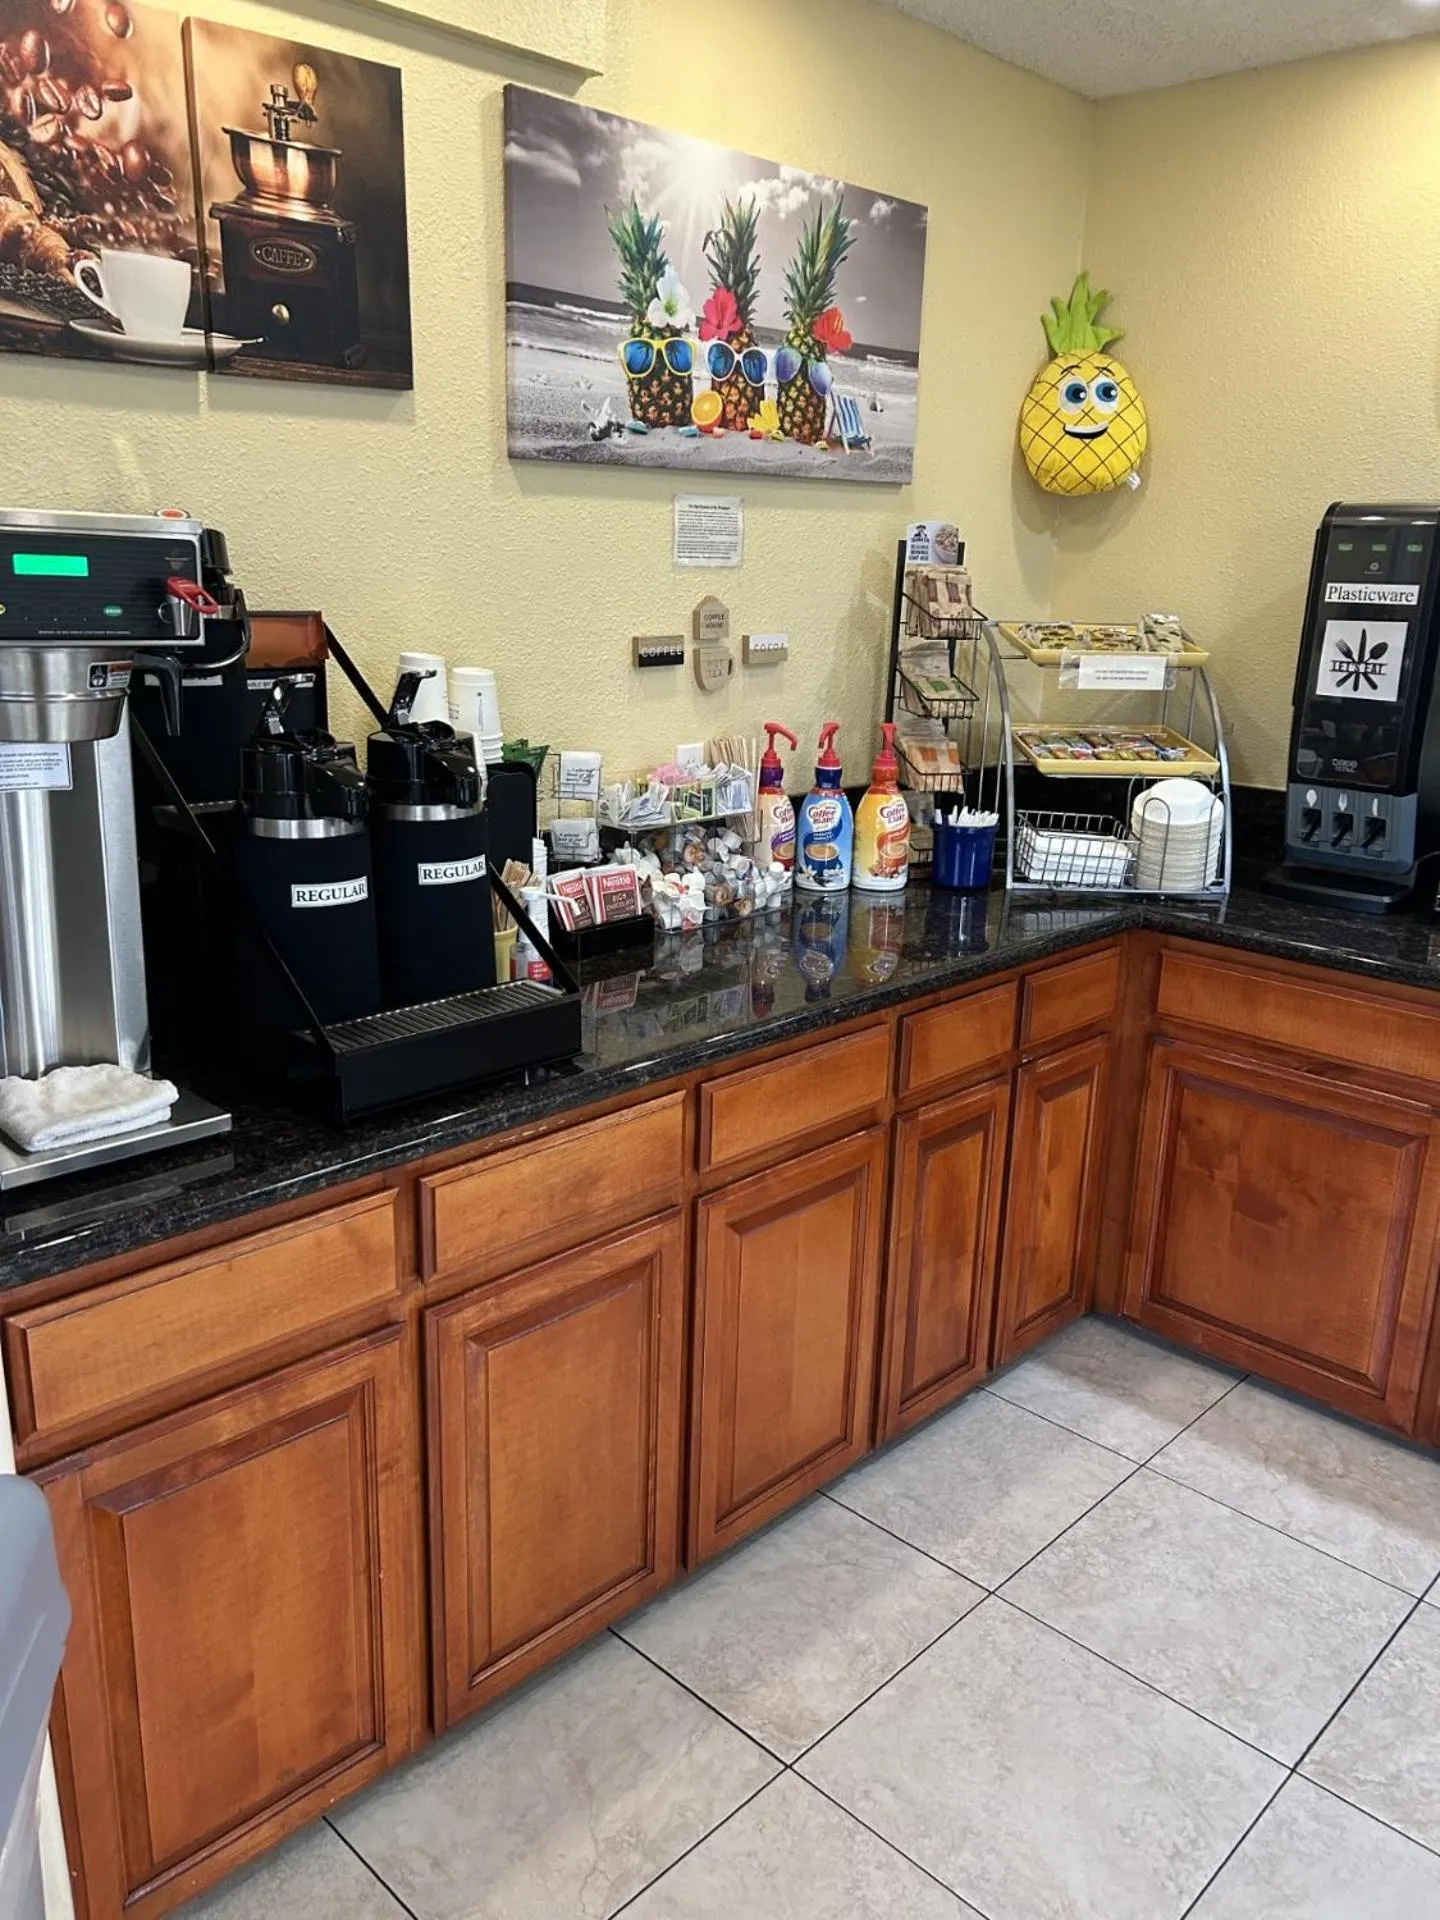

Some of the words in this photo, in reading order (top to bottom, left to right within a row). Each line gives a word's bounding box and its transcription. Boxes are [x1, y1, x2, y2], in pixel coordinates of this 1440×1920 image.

[1328, 585, 1415, 602] Plasticware
[643, 645, 682, 657] COFFEE
[1363, 662, 1387, 675] EAT
[423, 860, 485, 880] REGULAR
[295, 882, 366, 902] REGULAR
